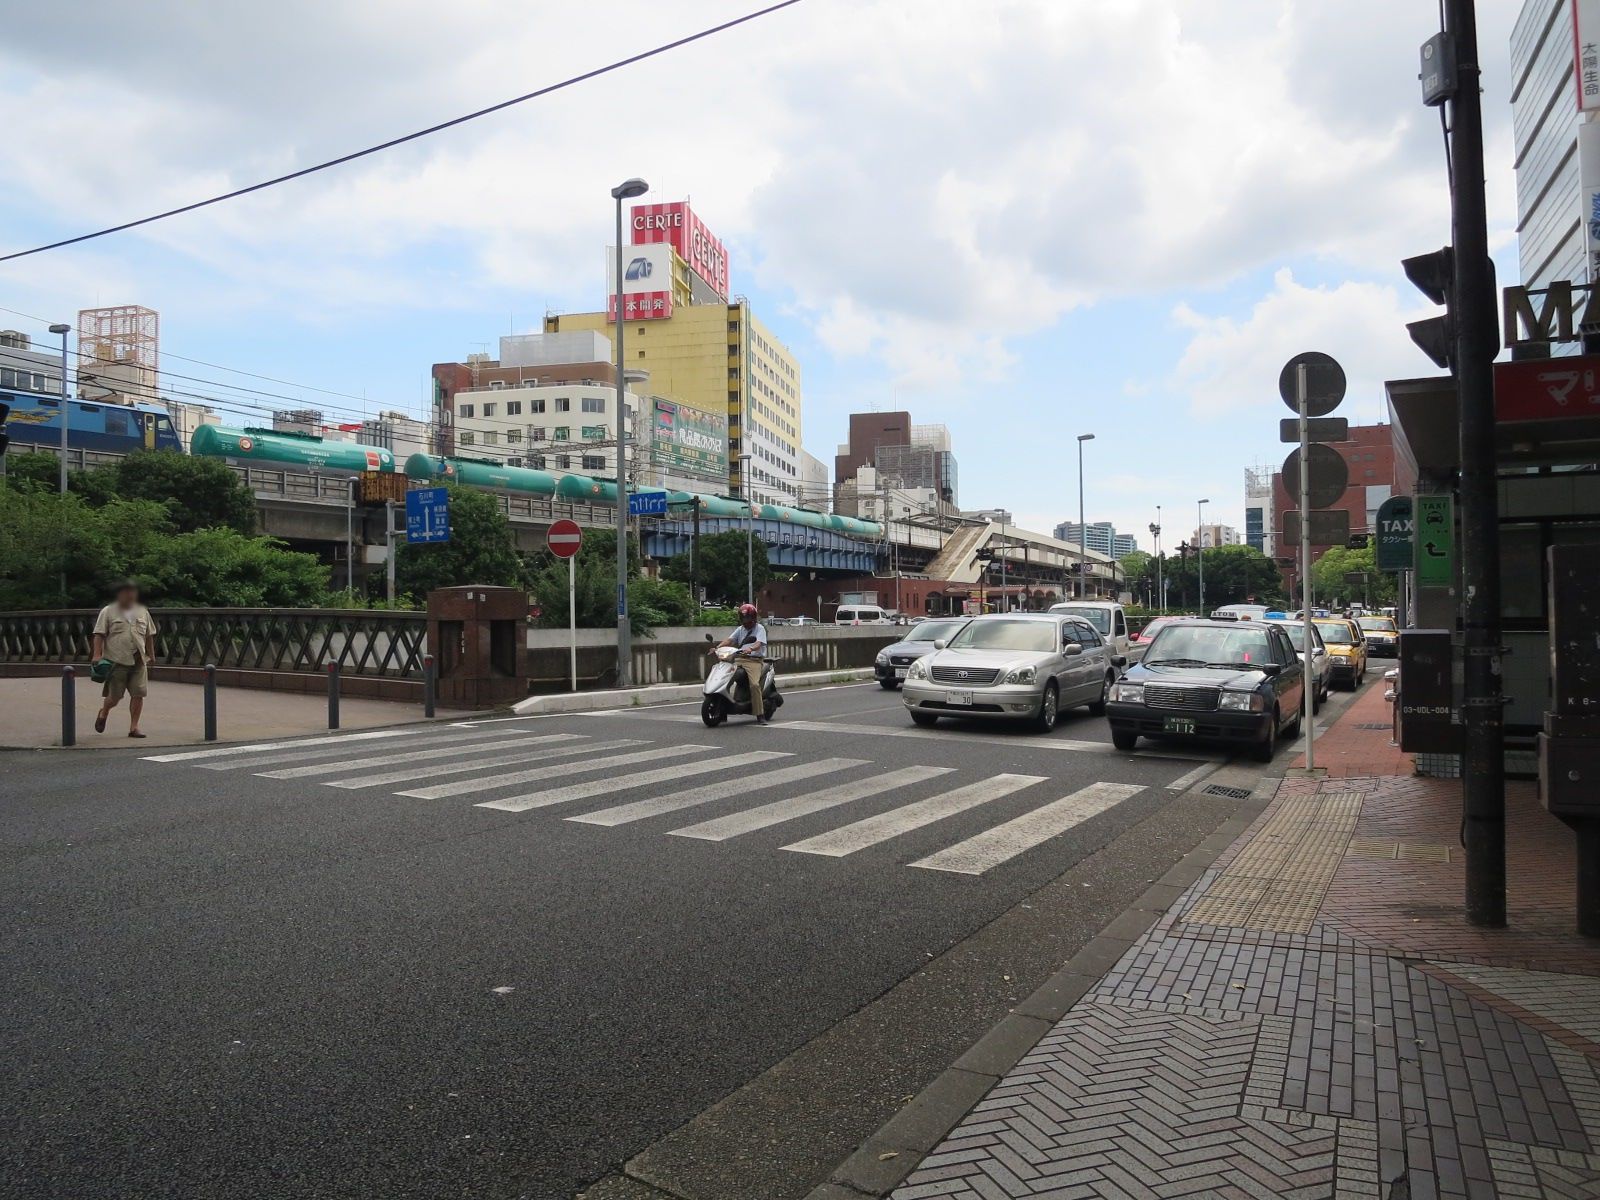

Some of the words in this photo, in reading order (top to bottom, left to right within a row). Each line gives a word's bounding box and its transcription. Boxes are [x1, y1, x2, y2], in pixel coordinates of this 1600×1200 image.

[633, 212, 683, 231] CERTE
[692, 226, 725, 287] CERTE
[614, 298, 665, 312] 本開発
[679, 427, 722, 453] 食品館あおば
[1423, 502, 1446, 510] TAXI
